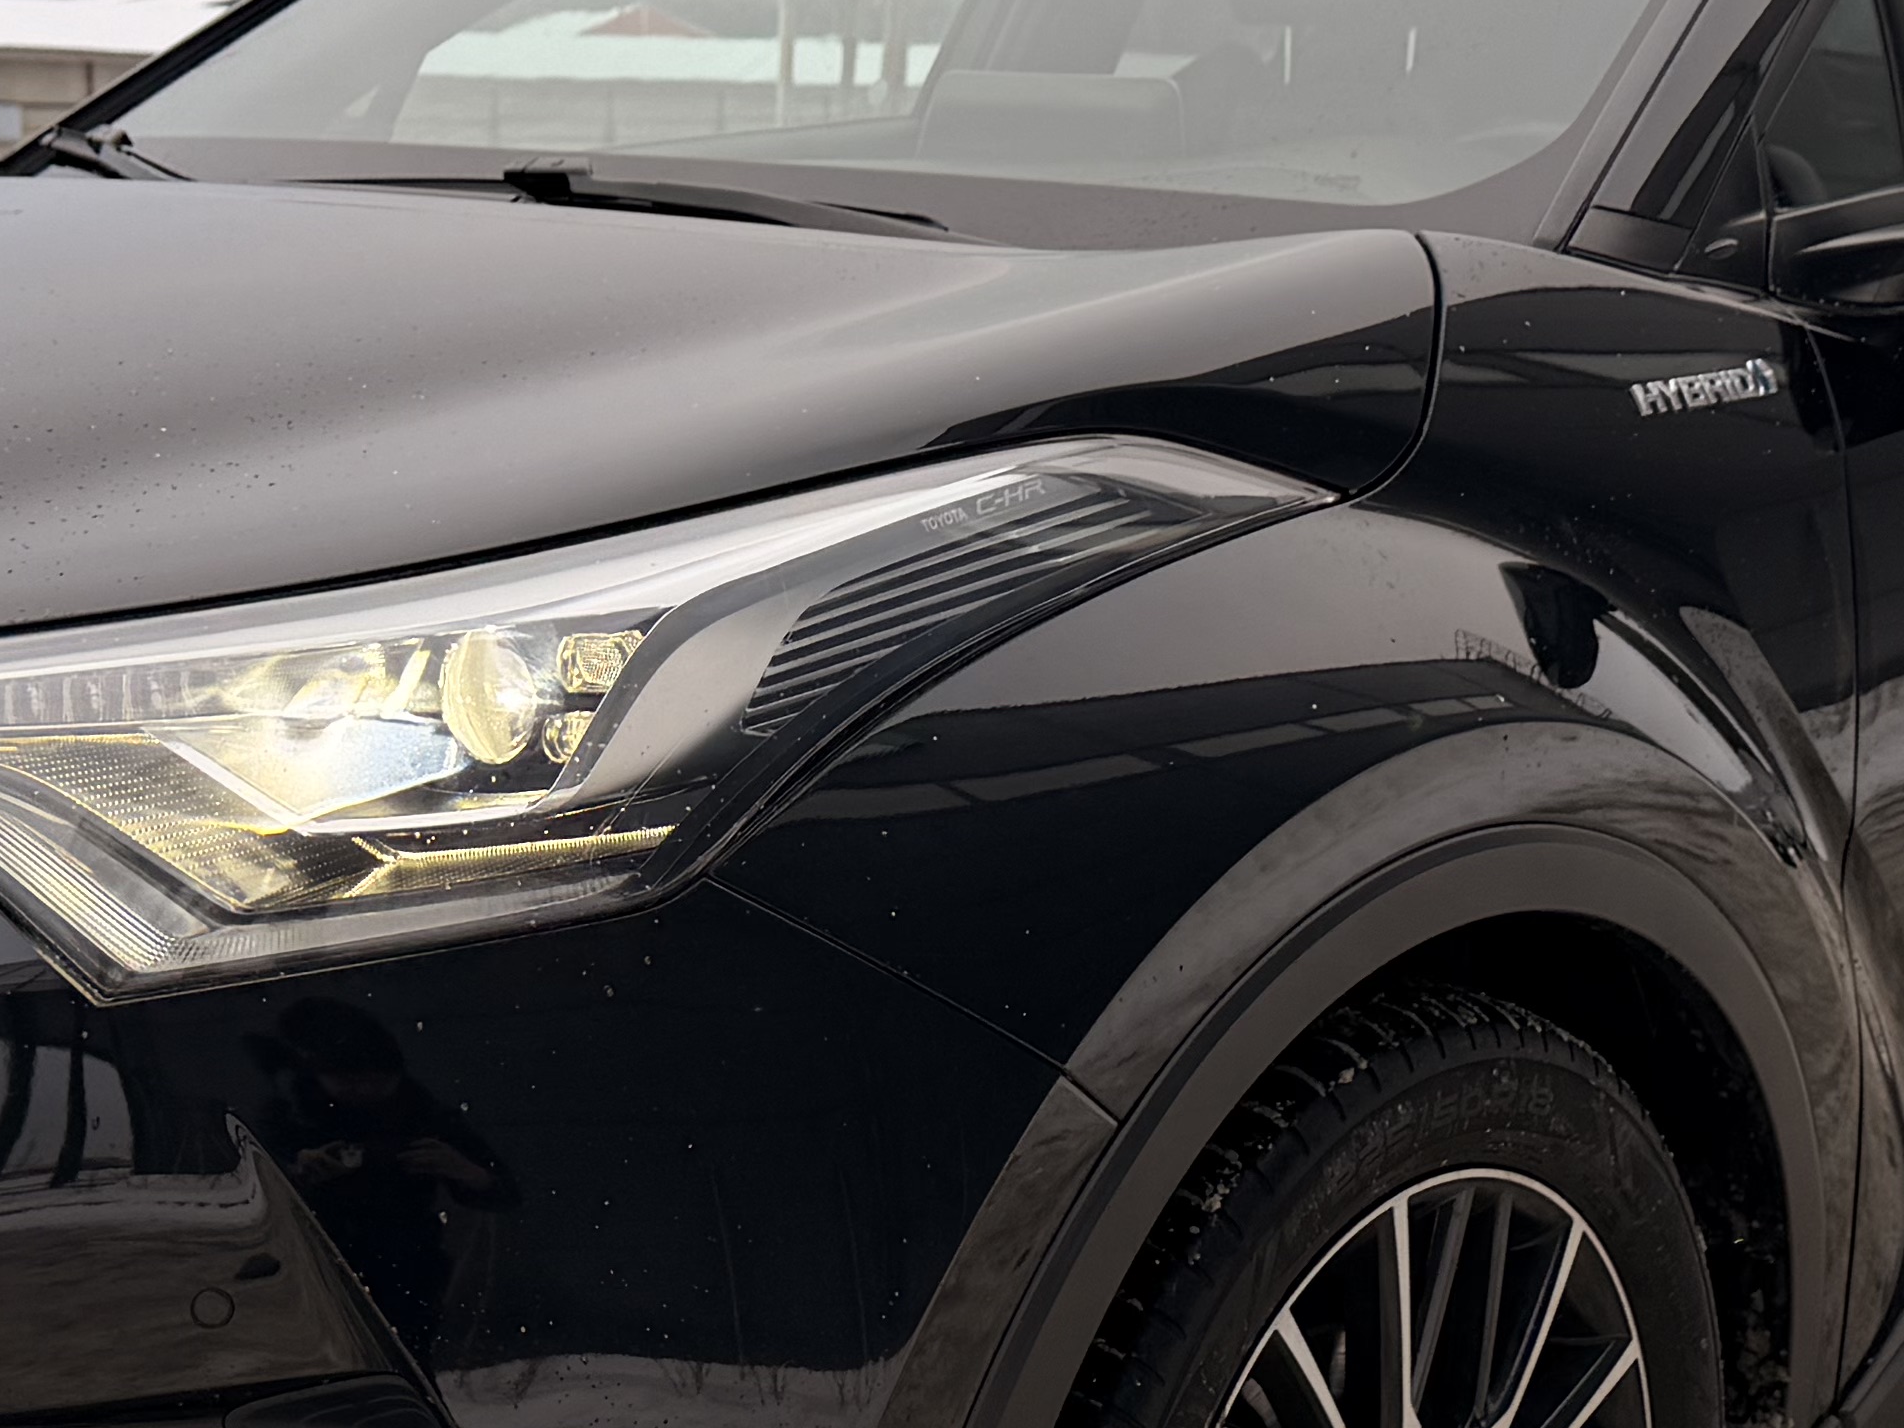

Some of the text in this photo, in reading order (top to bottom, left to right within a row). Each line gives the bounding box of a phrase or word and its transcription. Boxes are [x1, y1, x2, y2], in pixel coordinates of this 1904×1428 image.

[1629, 368, 1756, 416] HYBRID
[922, 479, 1045, 532] TOYOTA C-HR
